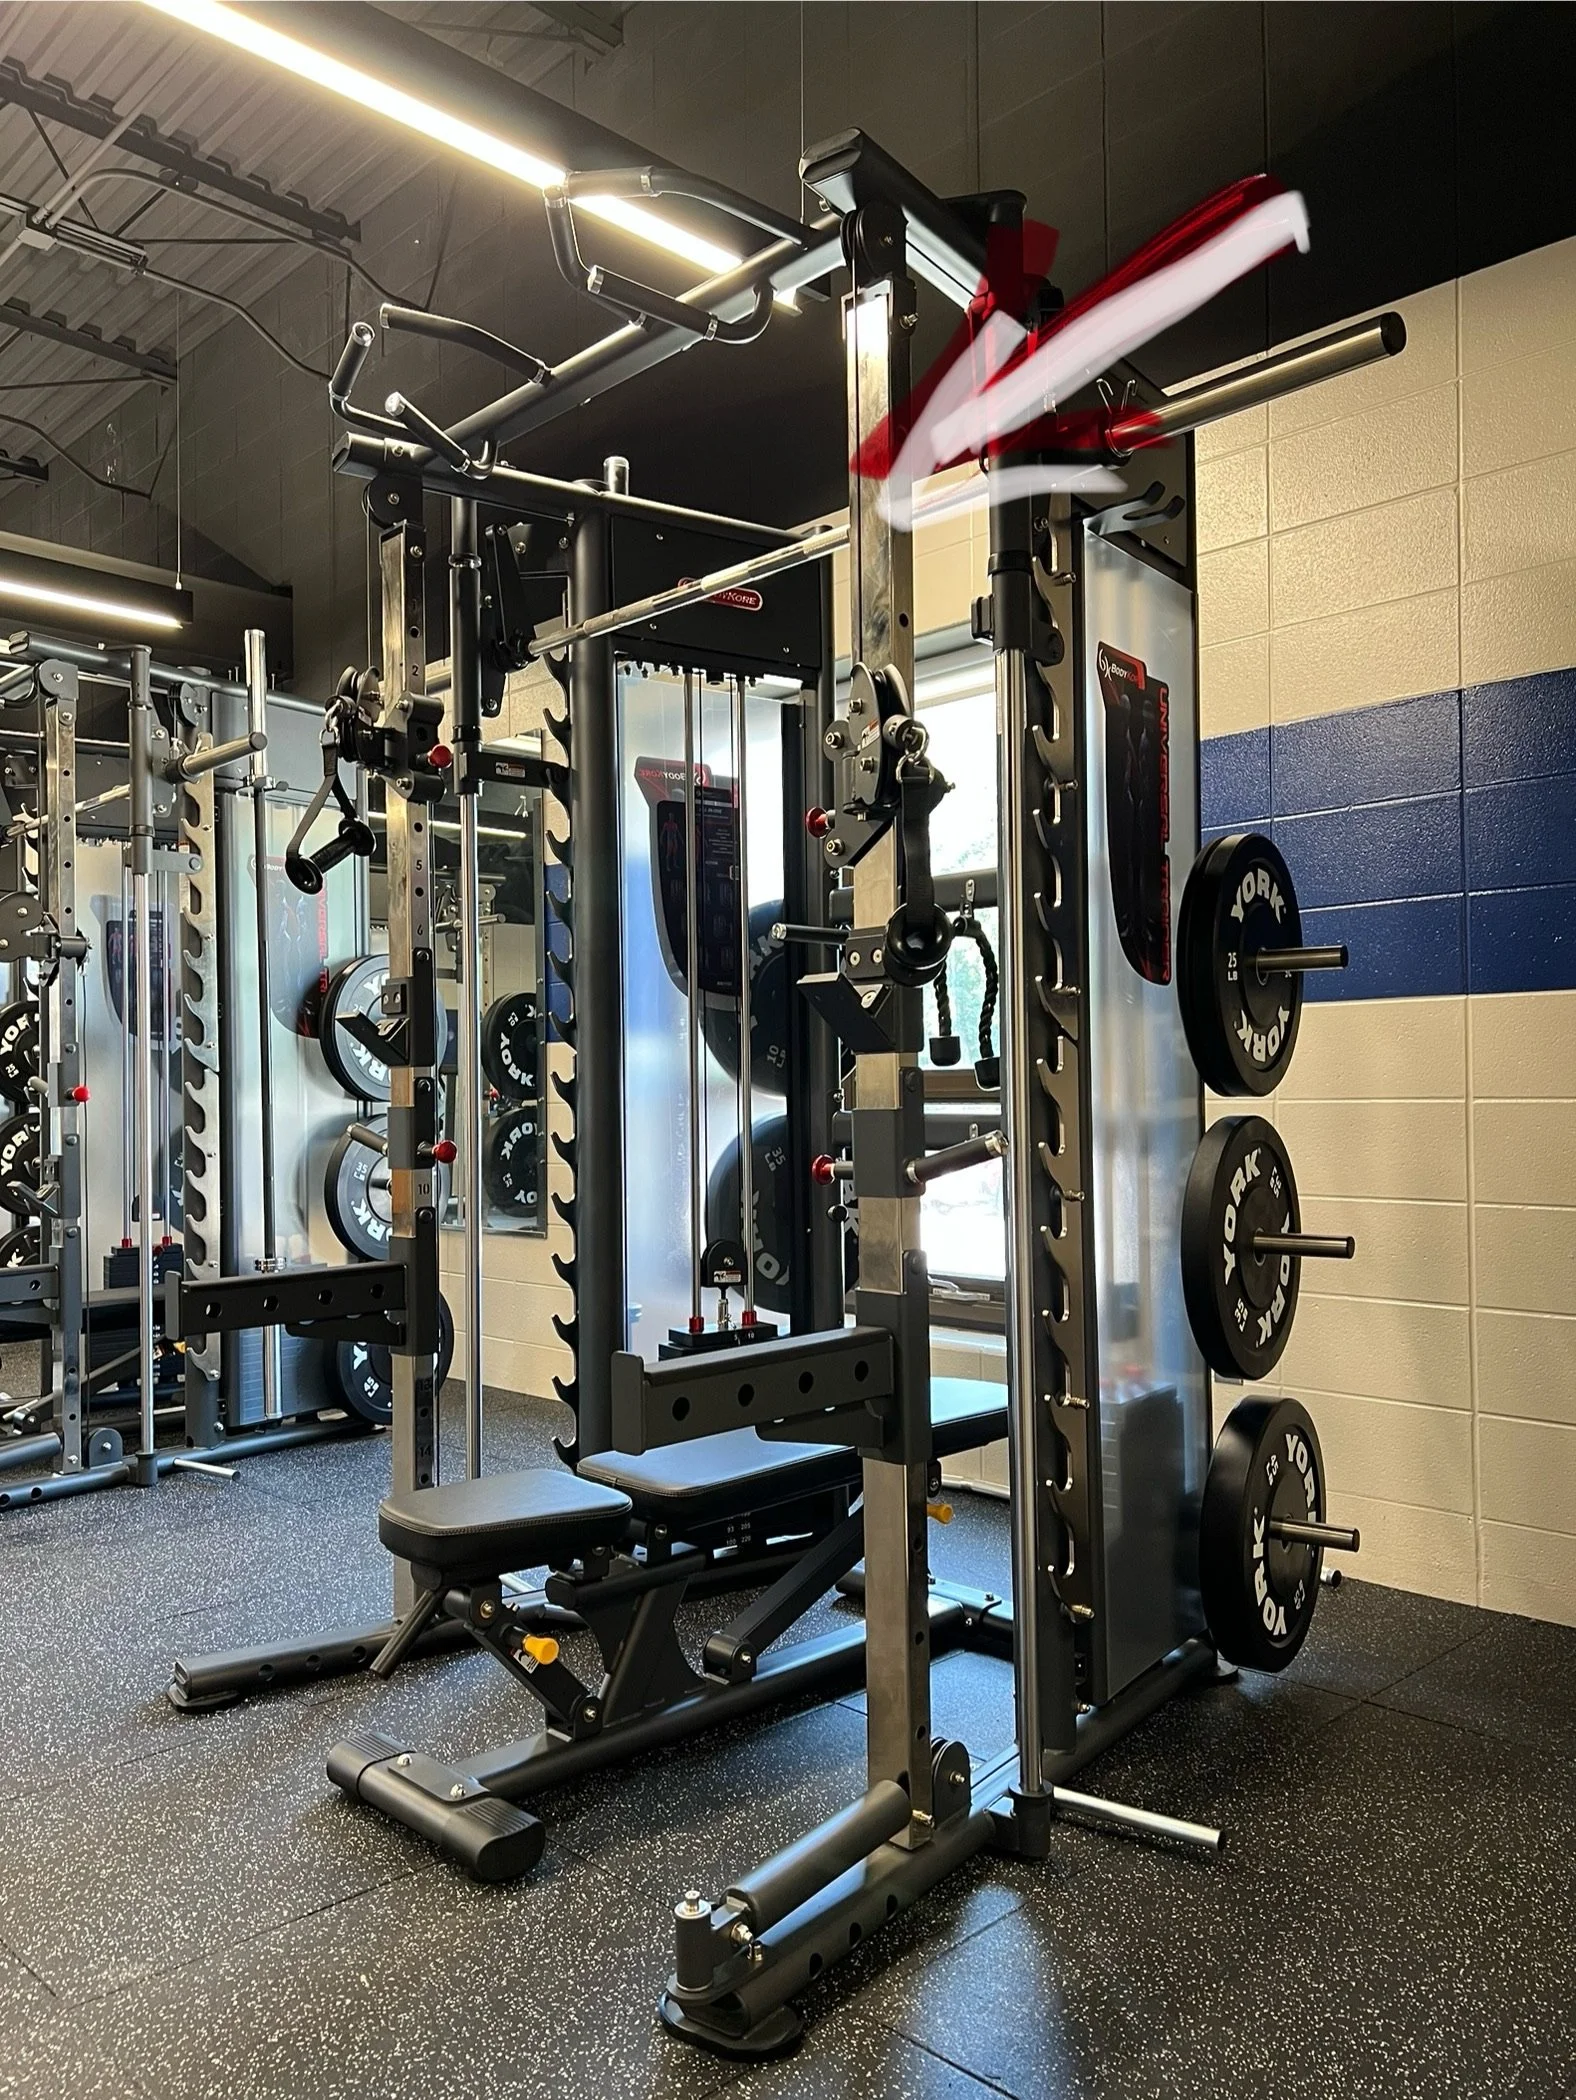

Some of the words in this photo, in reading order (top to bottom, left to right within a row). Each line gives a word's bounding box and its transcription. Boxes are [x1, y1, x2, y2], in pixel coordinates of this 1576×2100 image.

[714, 590, 757, 605] YKORE
[411, 665, 419, 676] 2
[1110, 663, 1137, 682] BODYKO
[1159, 687, 1169, 851] UNIVERSAL
[416, 859, 423, 871] 5
[1230, 868, 1285, 923] YORK
[416, 924, 423, 936] 6
[1160, 860, 1169, 981] TRAINER
[1227, 953, 1237, 968] 25
[1227, 968, 1238, 981] LB
[0, 1013, 39, 1055] YOR
[1236, 1005, 1290, 1062] YORK
[352, 1043, 391, 1082] RK
[767, 1044, 779, 1065] 10
[5, 1063, 15, 1074] 25
[0, 1125, 40, 1176] YOR
[771, 1146, 786, 1165] 35
[357, 1162, 368, 1174] 35
[765, 1152, 776, 1172] LB
[418, 1183, 430, 1195] 10
[353, 1198, 392, 1241] RK
[1223, 1148, 1261, 1285] YORK
[419, 1446, 431, 1457] 14
[1270, 1454, 1279, 1476] 45
[740, 1522, 751, 1531] 205
[741, 1535, 752, 1543] 220
[1253, 1515, 1287, 1636] YORK
